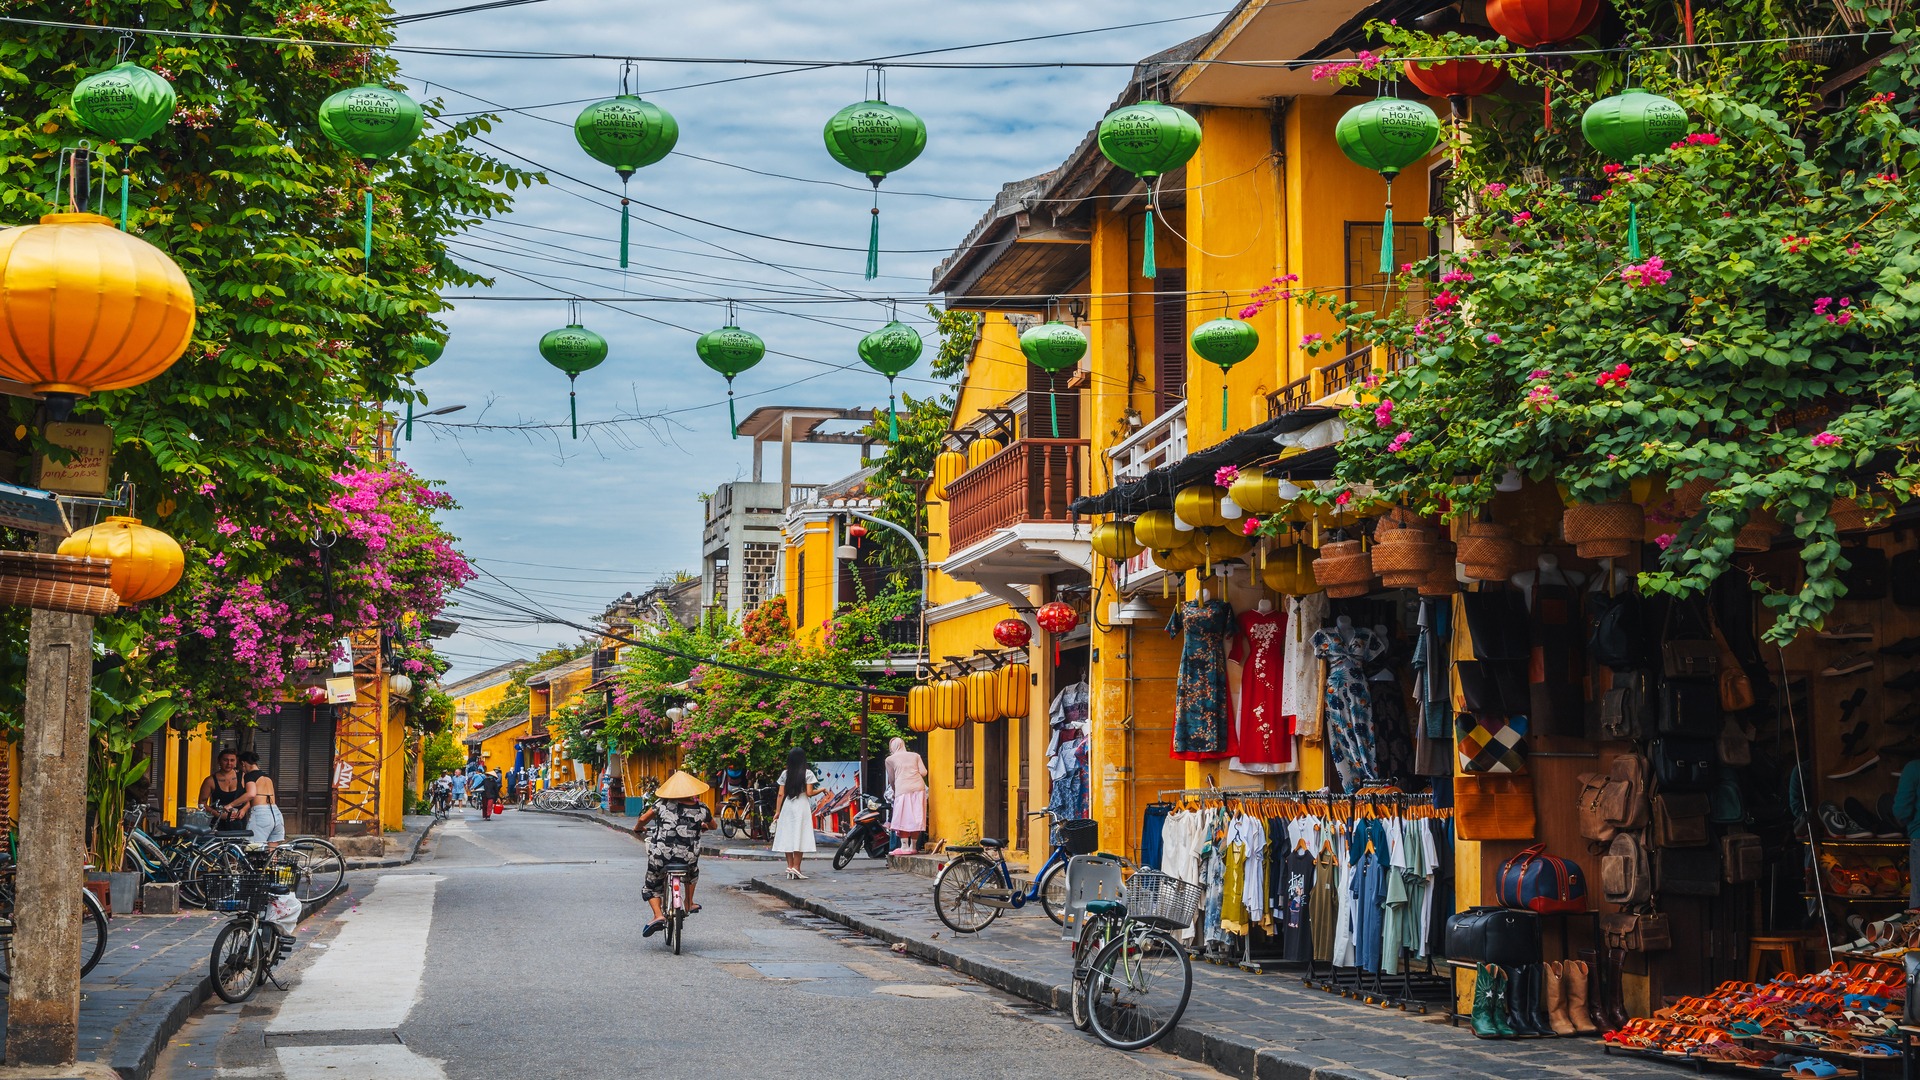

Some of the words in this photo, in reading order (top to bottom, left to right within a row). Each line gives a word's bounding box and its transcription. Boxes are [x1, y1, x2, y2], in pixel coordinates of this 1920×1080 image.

[93, 89, 109, 97] HOI
[87, 94, 133, 104] ROASTERY
[348, 105, 397, 115] ROASTERY
[621, 113, 636, 121] AN
[1389, 111, 1406, 119] HOI
[1407, 113, 1420, 121] AN
[1671, 112, 1680, 120] AN
[596, 119, 644, 128] ROASTERY
[857, 119, 873, 127] HOI
[875, 119, 889, 127] AN
[1135, 121, 1150, 129] AN
[1382, 117, 1427, 128] ROASTERY
[851, 126, 898, 134] ROASTERY
[1112, 127, 1158, 137] ROASTERY
[338, 760, 353, 789] ATM
